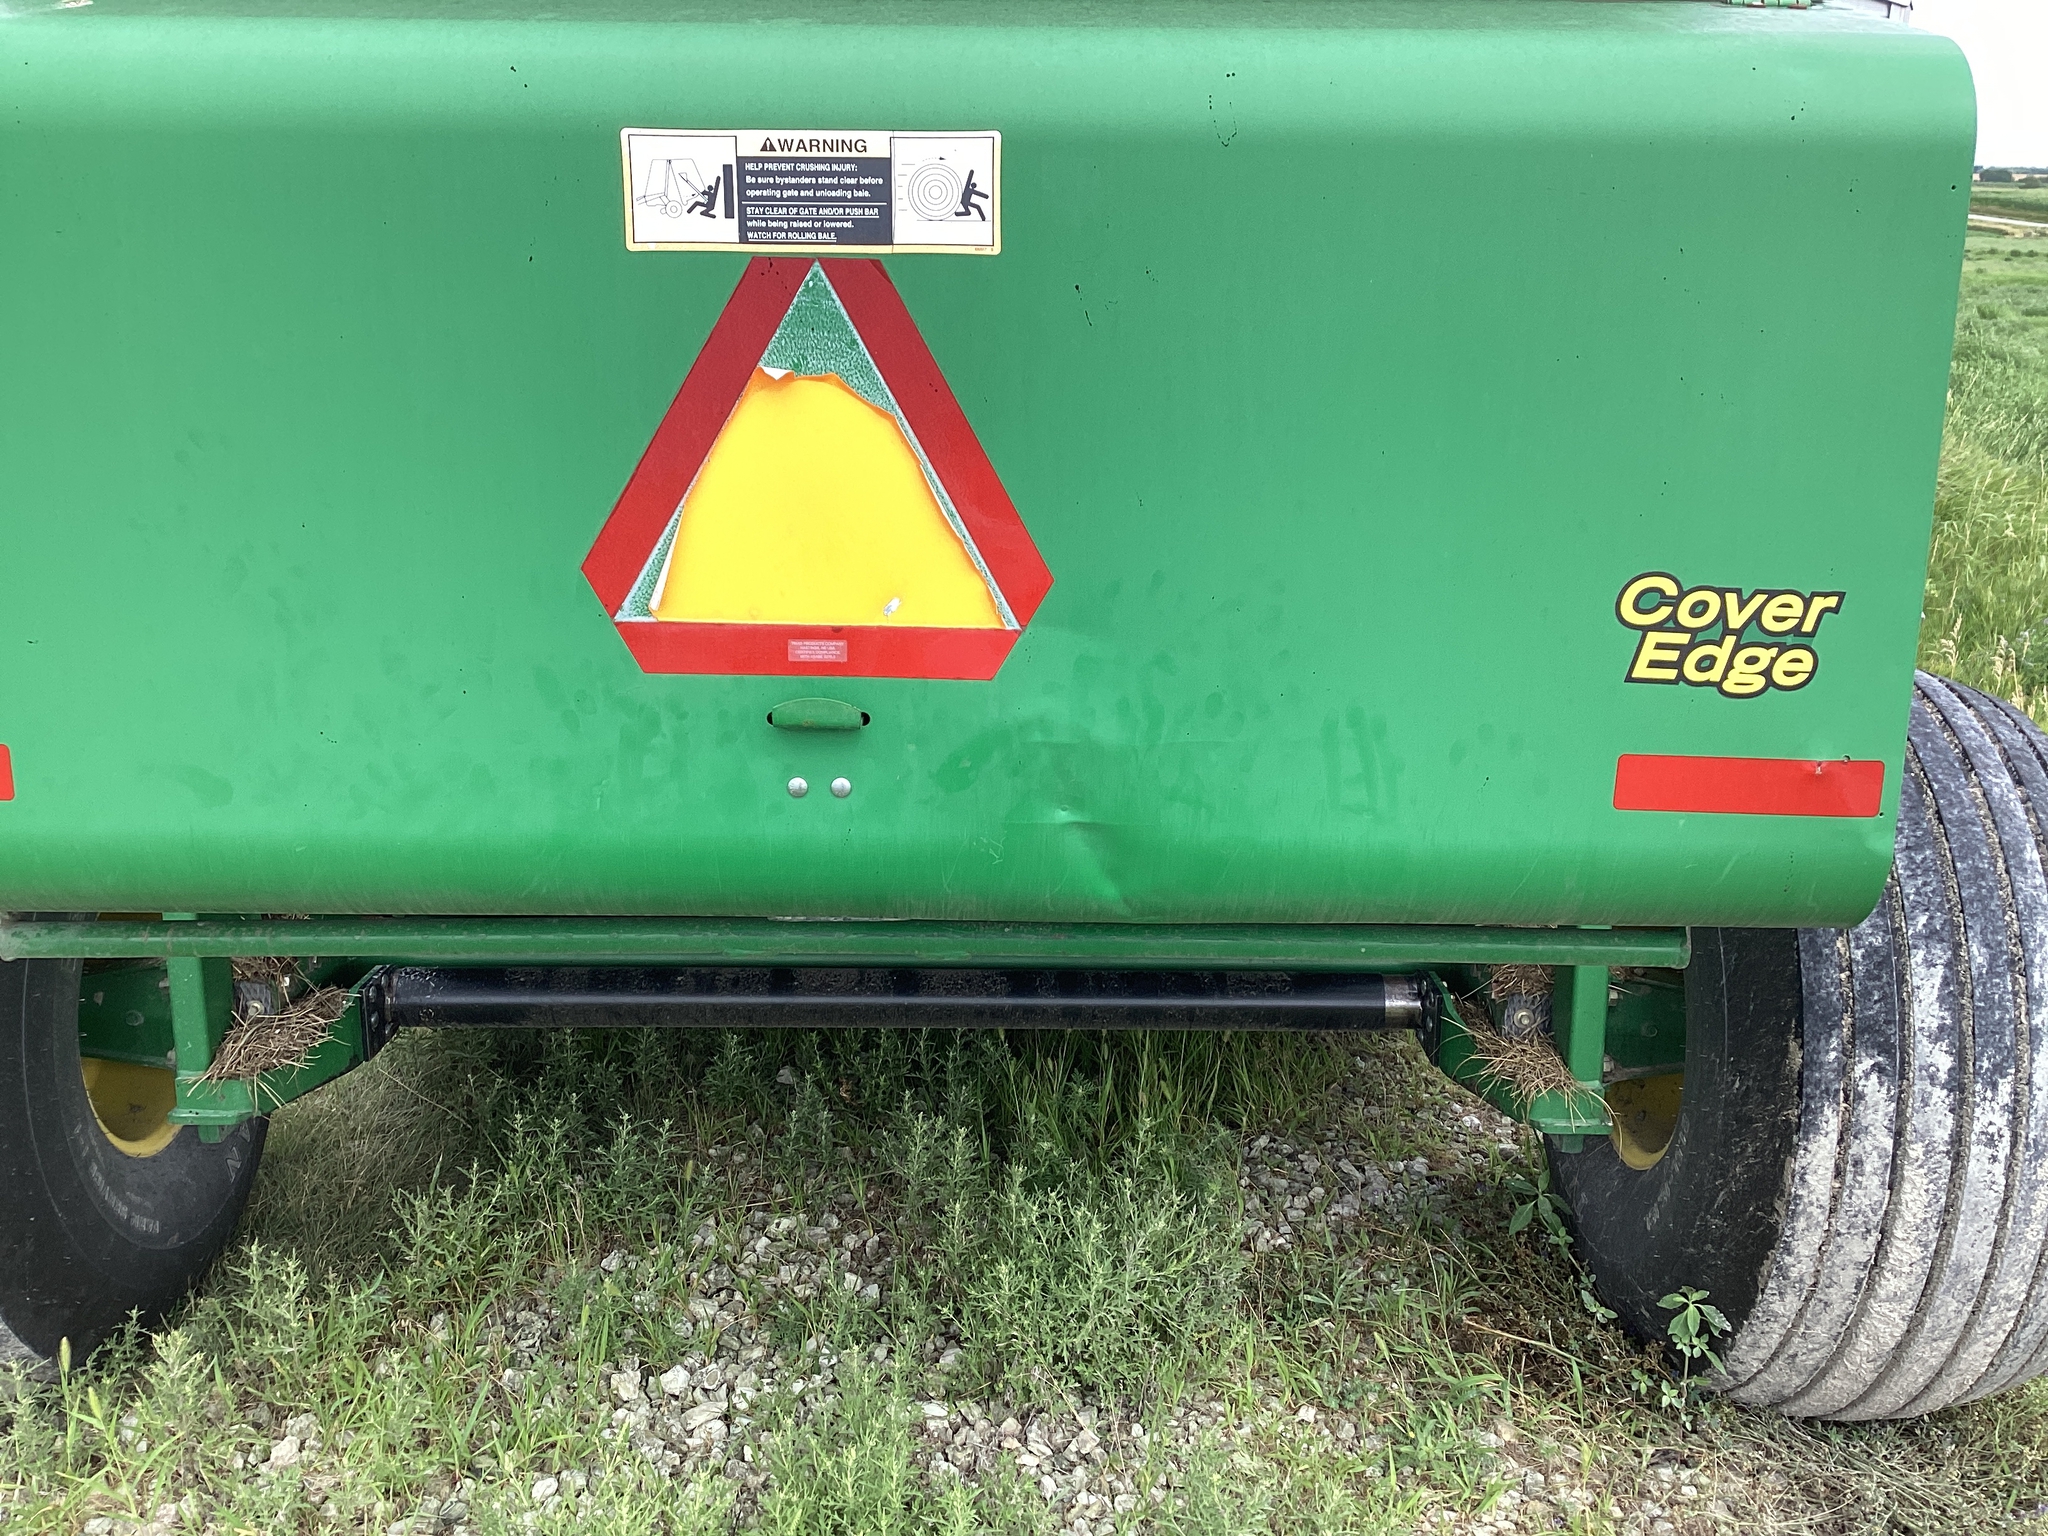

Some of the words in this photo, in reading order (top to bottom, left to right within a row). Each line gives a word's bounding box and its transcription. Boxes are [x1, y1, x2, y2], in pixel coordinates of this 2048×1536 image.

[778, 139, 867, 153] WARNING
[764, 163, 794, 171] PREVENT
[796, 163, 830, 171] CRUSHING
[746, 175, 755, 184] Be
[757, 176, 774, 184] sure
[775, 176, 816, 185] bystanders
[817, 176, 838, 184] stand
[840, 176, 857, 184] clear
[746, 189, 780, 198] operating
[782, 190, 798, 198] gate
[816, 190, 852, 198] unloading
[768, 220, 788, 229] being
[790, 220, 812, 228] raised
[788, 232, 816, 240] ROLLING
[818, 232, 837, 240] BALE.
[1616, 572, 1845, 636] Cover
[1625, 631, 1818, 698] Edge
